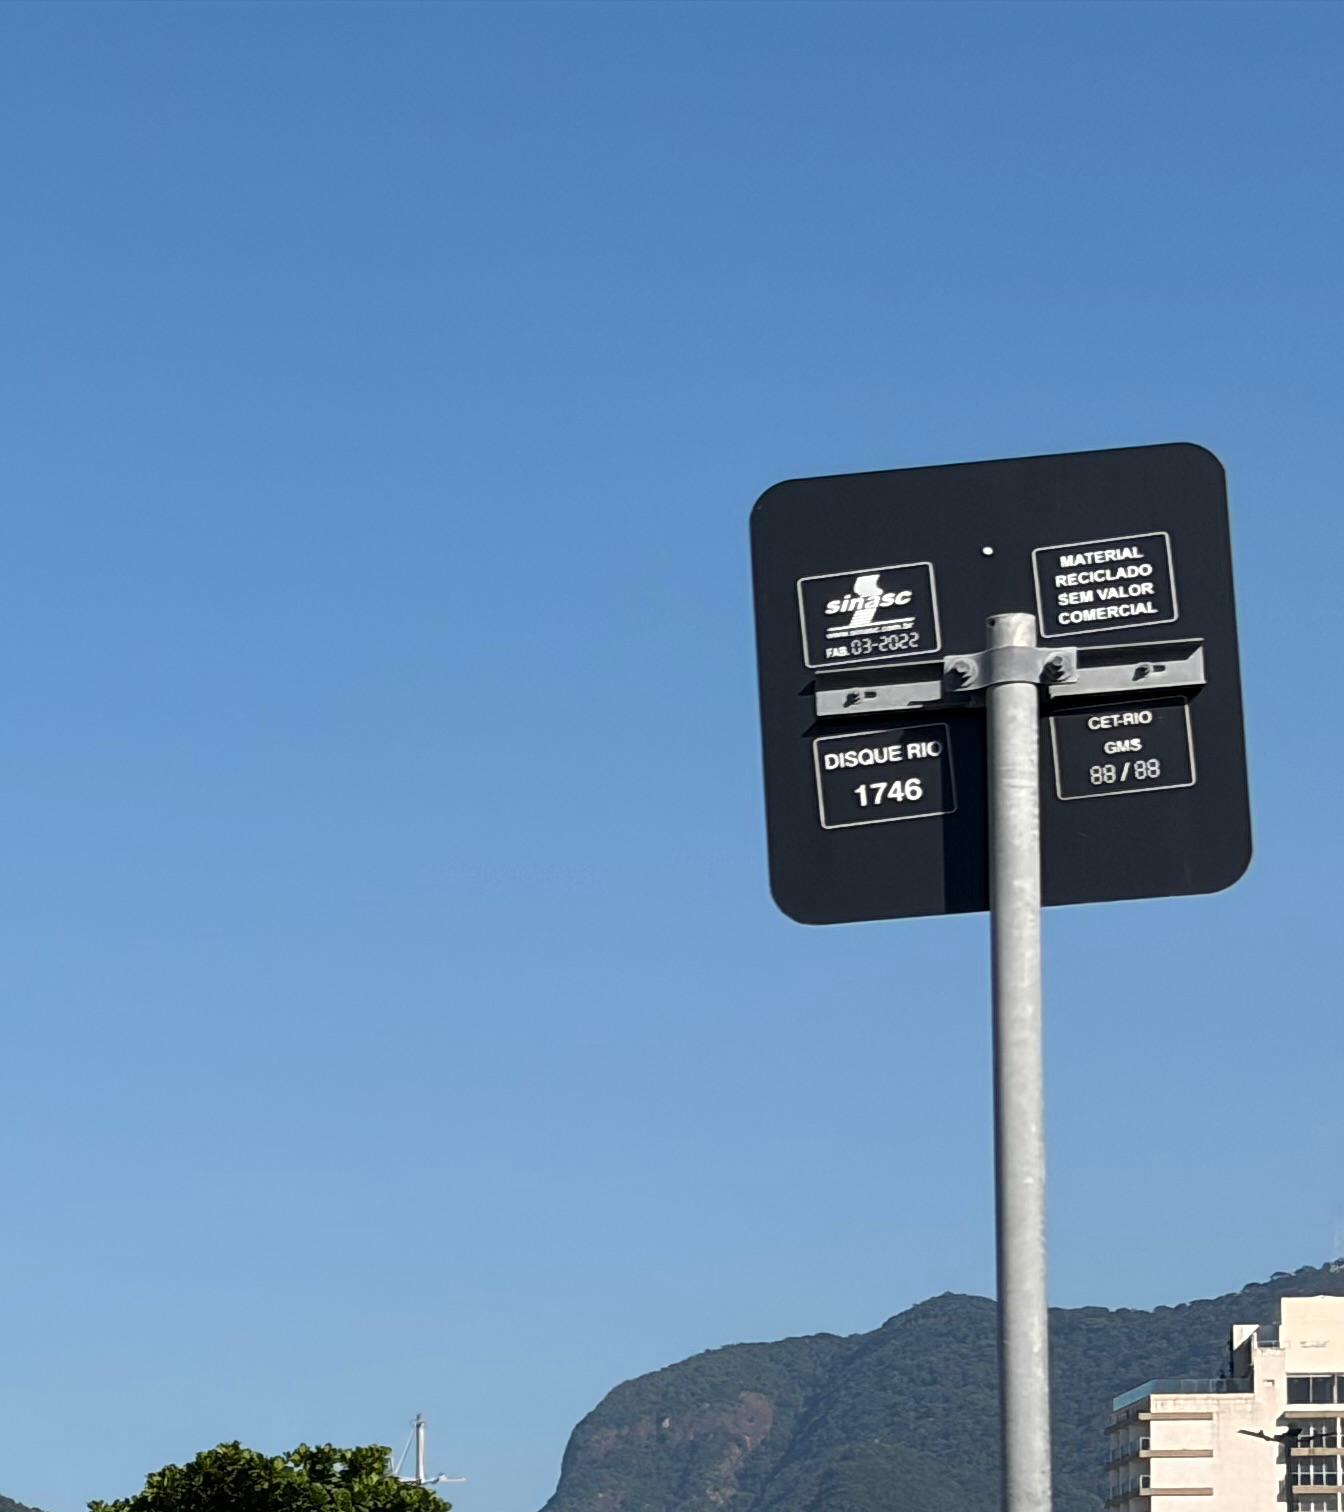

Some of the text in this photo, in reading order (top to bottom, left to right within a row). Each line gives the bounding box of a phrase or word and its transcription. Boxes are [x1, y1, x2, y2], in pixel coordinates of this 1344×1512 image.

[1059, 546, 1144, 568] MATERIAL
[1055, 563, 1153, 588] RECICLADO
[824, 590, 913, 615] sinasc
[1058, 582, 1155, 606] SEM VALOR
[1058, 601, 1159, 625] COMERCIAL
[851, 631, 920, 656] 03-2022
[1088, 710, 1152, 730] CET-RIO
[824, 740, 943, 770] DISQUE RIO
[1104, 738, 1143, 754] GMS
[854, 777, 923, 807] 1746
